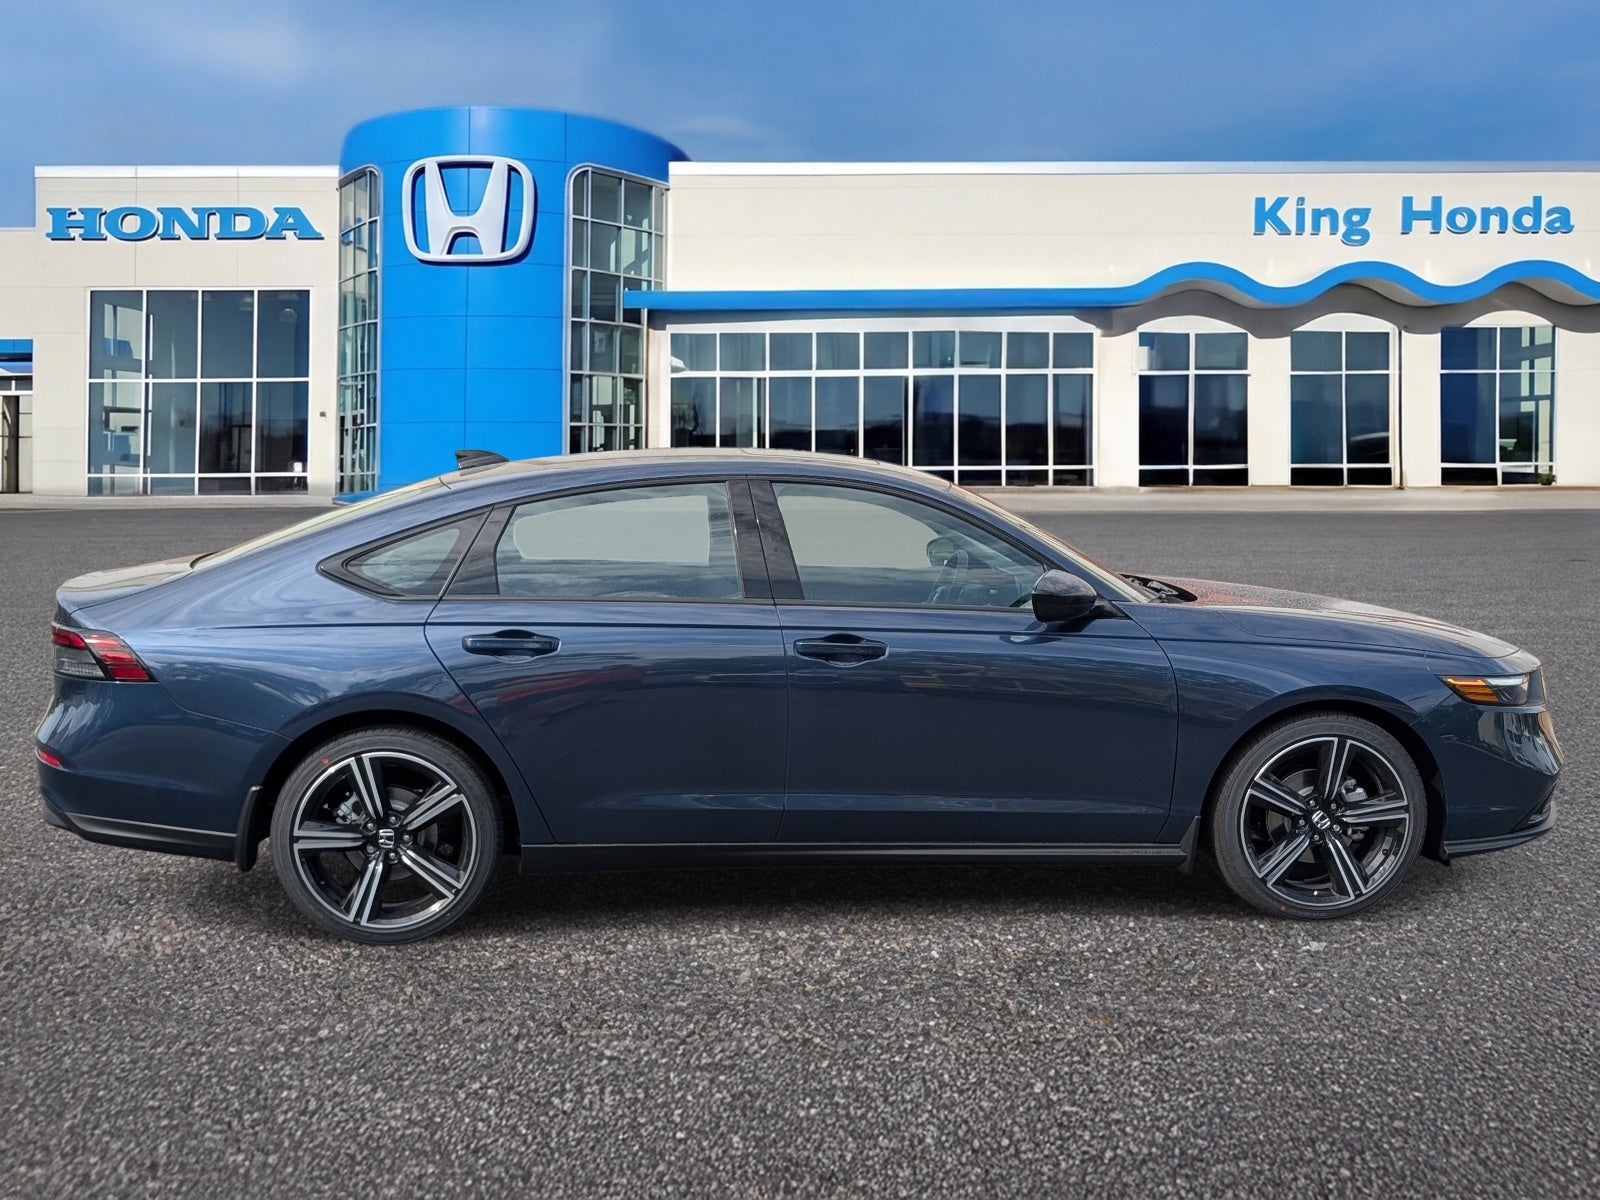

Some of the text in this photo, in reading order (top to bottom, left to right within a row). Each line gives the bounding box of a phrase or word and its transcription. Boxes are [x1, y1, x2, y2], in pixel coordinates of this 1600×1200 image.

[46, 206, 323, 241] HONDA
[1253, 195, 1575, 245] King Honda
